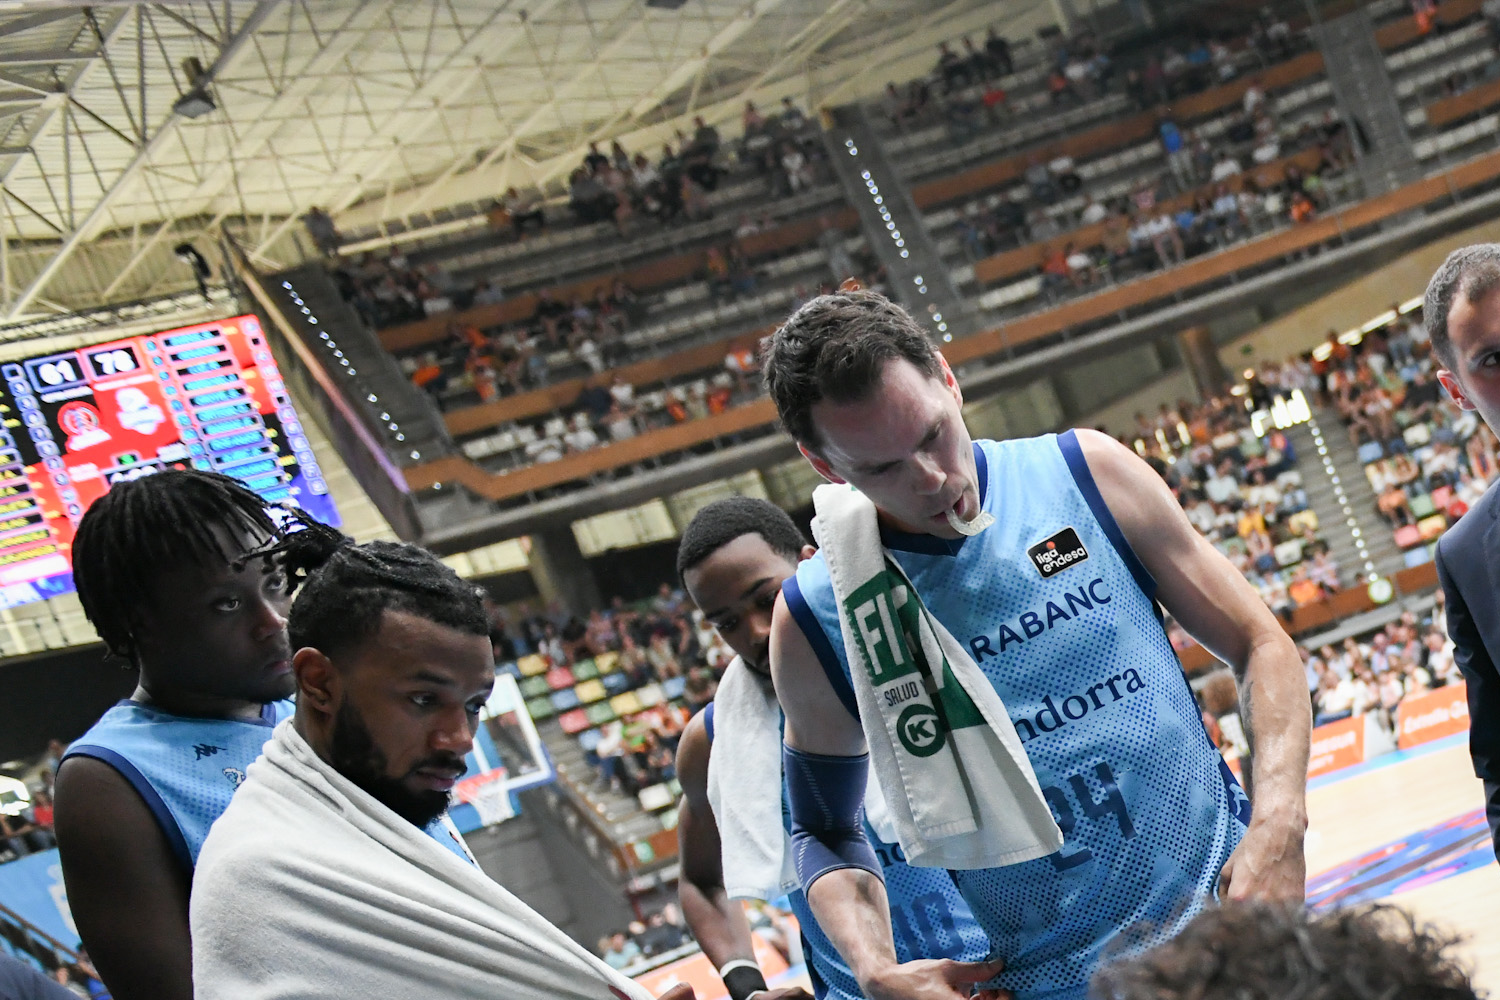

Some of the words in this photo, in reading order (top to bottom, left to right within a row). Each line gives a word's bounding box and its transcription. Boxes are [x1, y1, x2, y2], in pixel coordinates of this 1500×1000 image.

[1036, 549, 1059, 564] liga
[1043, 548, 1086, 572] endesa
[969, 578, 1112, 663] RABANC
[884, 681, 920, 707] SALUD
[1015, 668, 1146, 744] ndorra
